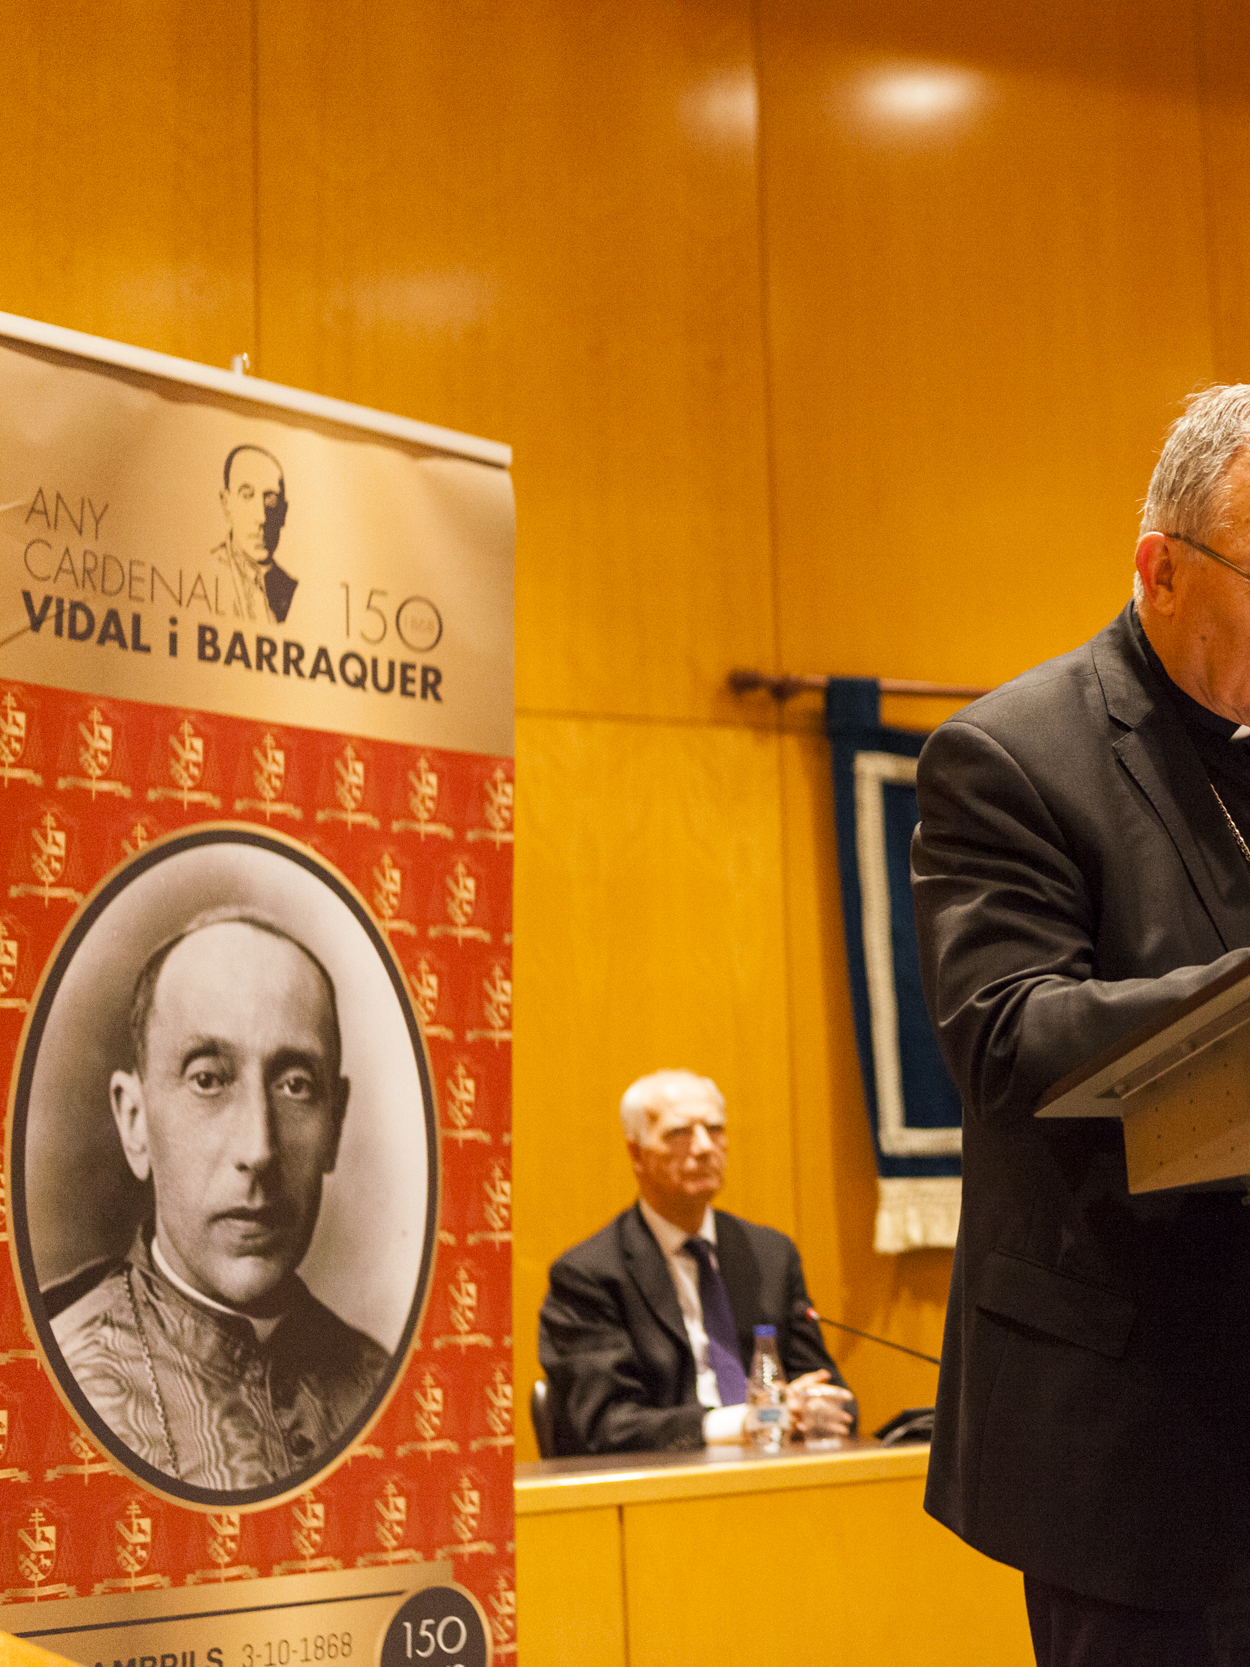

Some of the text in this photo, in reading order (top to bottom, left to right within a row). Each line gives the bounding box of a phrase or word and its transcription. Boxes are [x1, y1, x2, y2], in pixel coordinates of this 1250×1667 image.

[25, 487, 109, 541] ANY
[24, 539, 226, 616] CARDENAL
[22, 589, 443, 702] VIDAL i BARRAQUER
[341, 582, 443, 653] 150
[242, 1631, 353, 1667] 3-10-1868
[403, 1616, 467, 1659] 150
